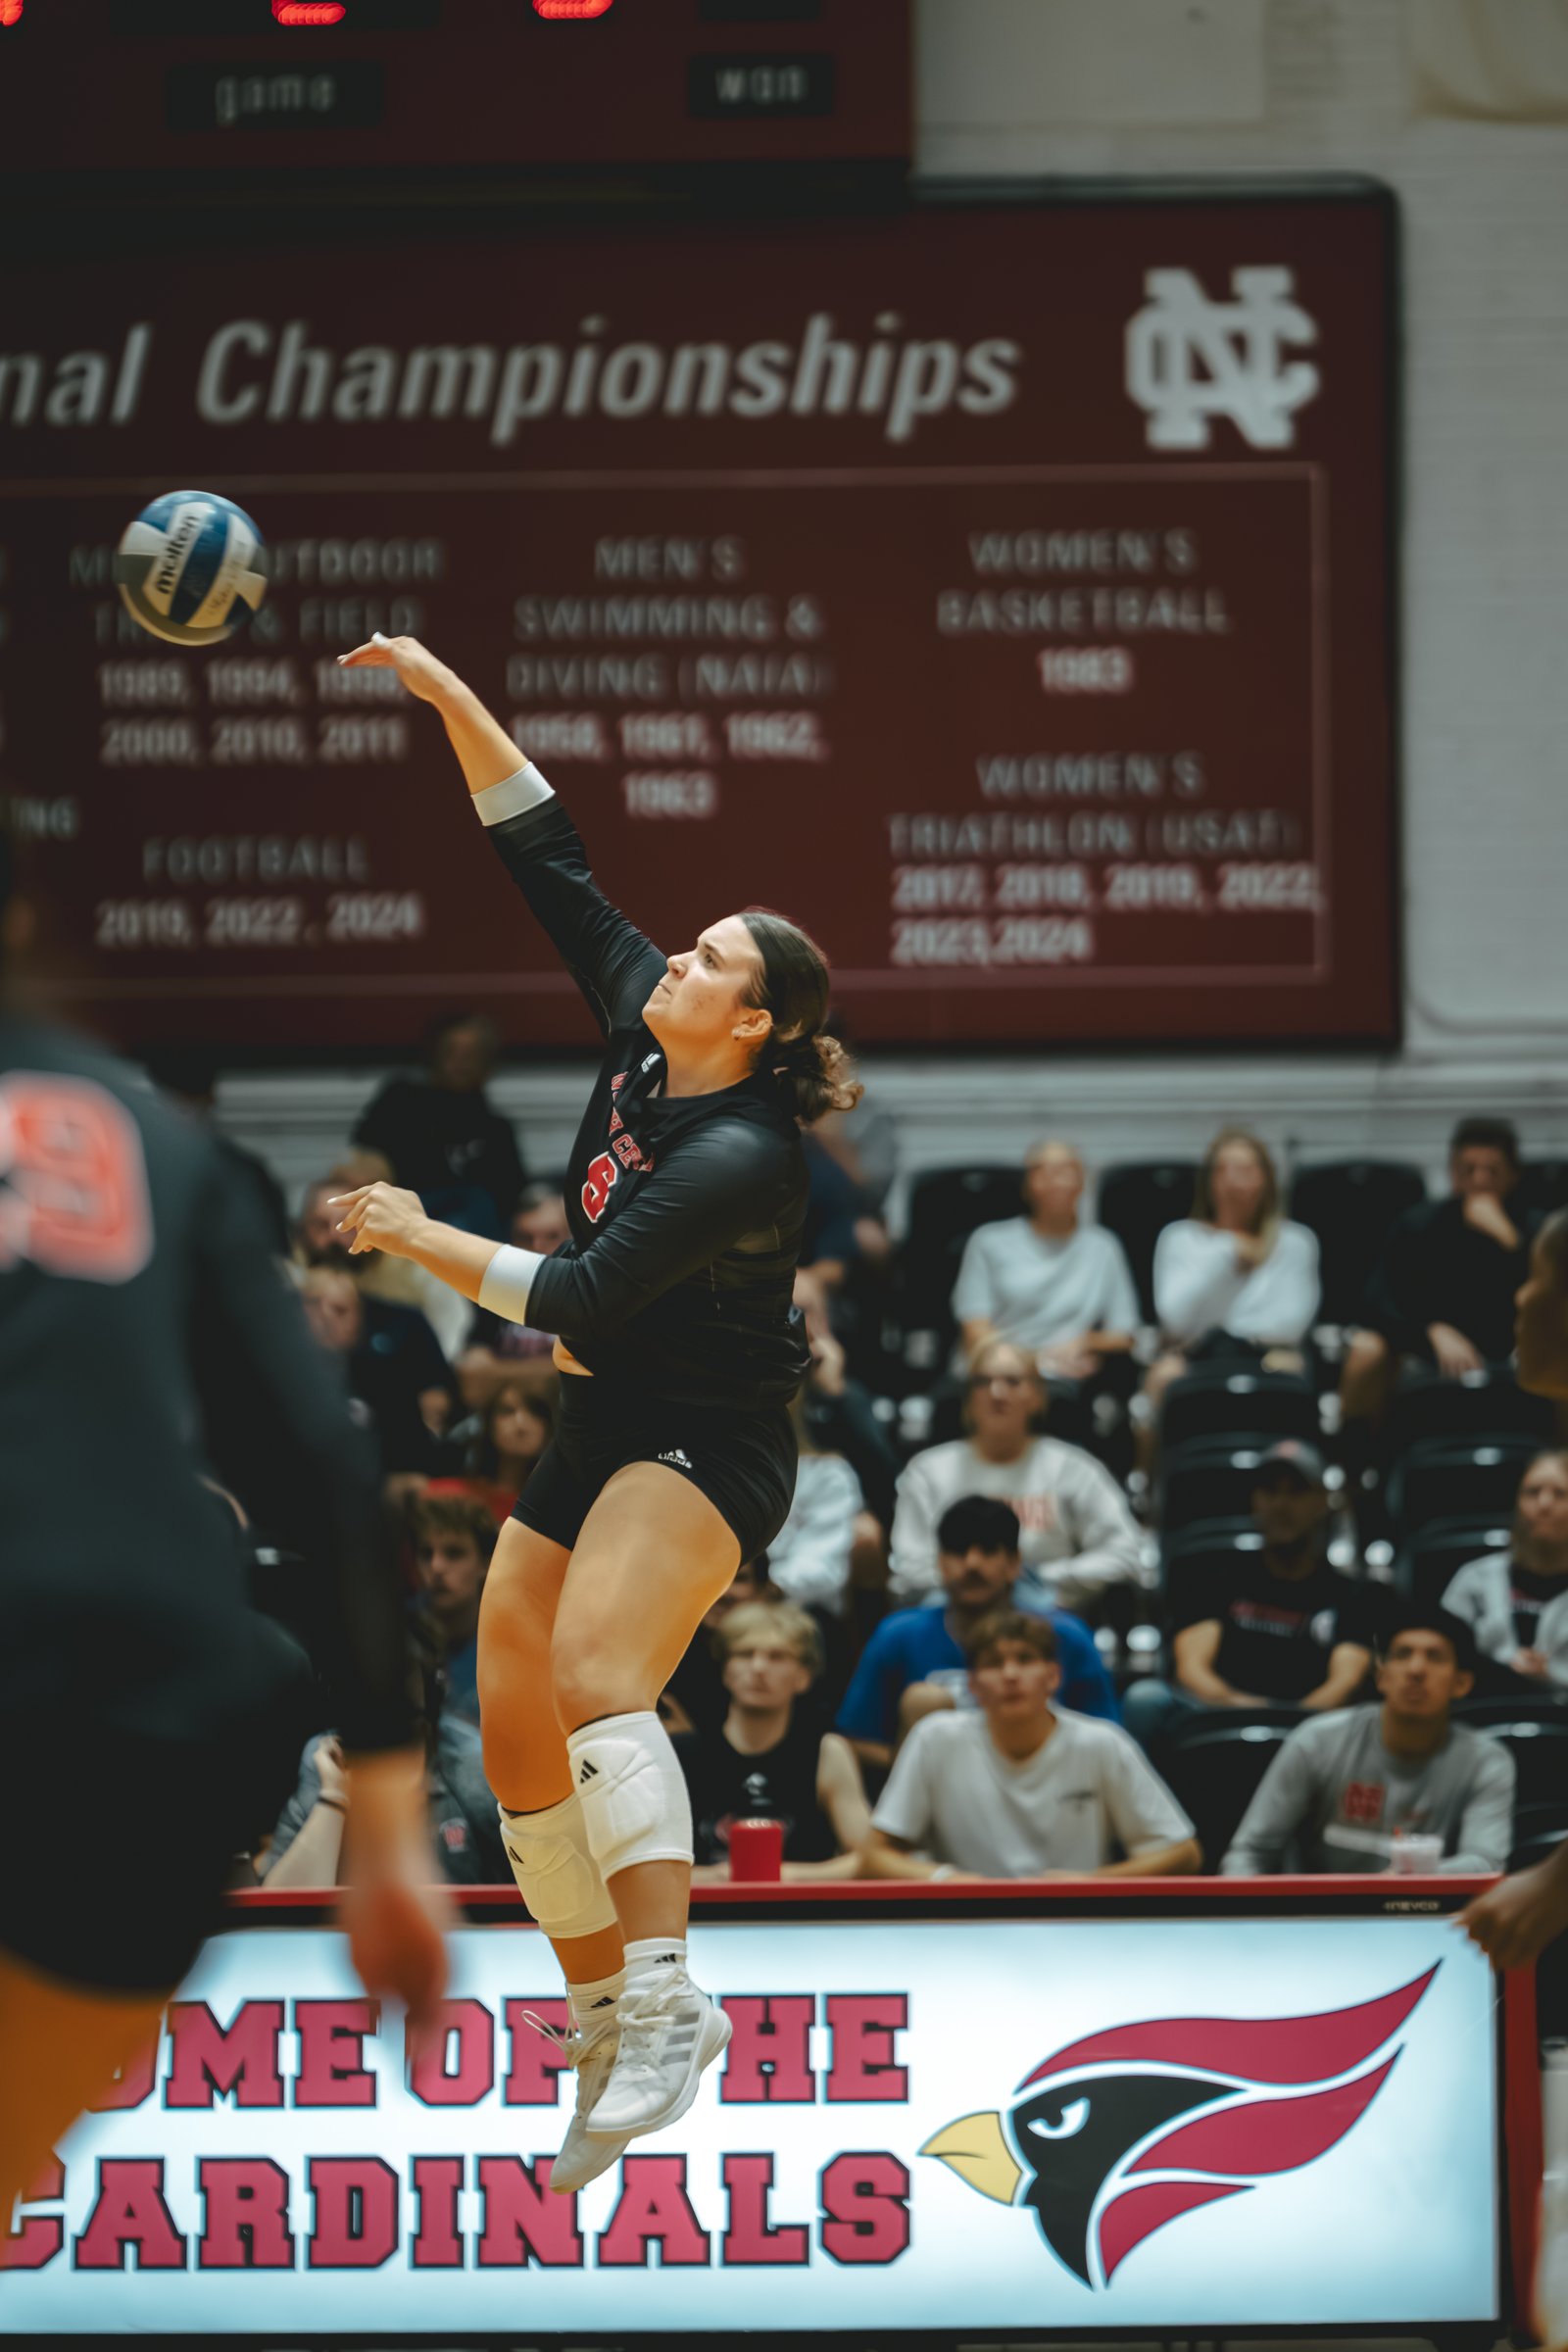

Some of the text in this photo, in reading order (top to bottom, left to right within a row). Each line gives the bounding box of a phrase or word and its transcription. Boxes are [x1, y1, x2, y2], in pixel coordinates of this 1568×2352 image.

[215, 74, 336, 125] game
[715, 65, 809, 105] won
[196, 316, 1021, 443] Championships
[155, 514, 199, 596] molten
[266, 539, 444, 580] UTDOOR
[595, 537, 743, 580] MEN'S
[970, 529, 1196, 572] WOMEN'S
[514, 595, 775, 640] SWIMMING
[936, 588, 1231, 632] BASKETBALL
[507, 654, 666, 700] DIVING
[977, 754, 1204, 797] WOMEN'S
[887, 811, 1135, 856] TRIATHLON
[142, 837, 367, 879] FOOTBALL
